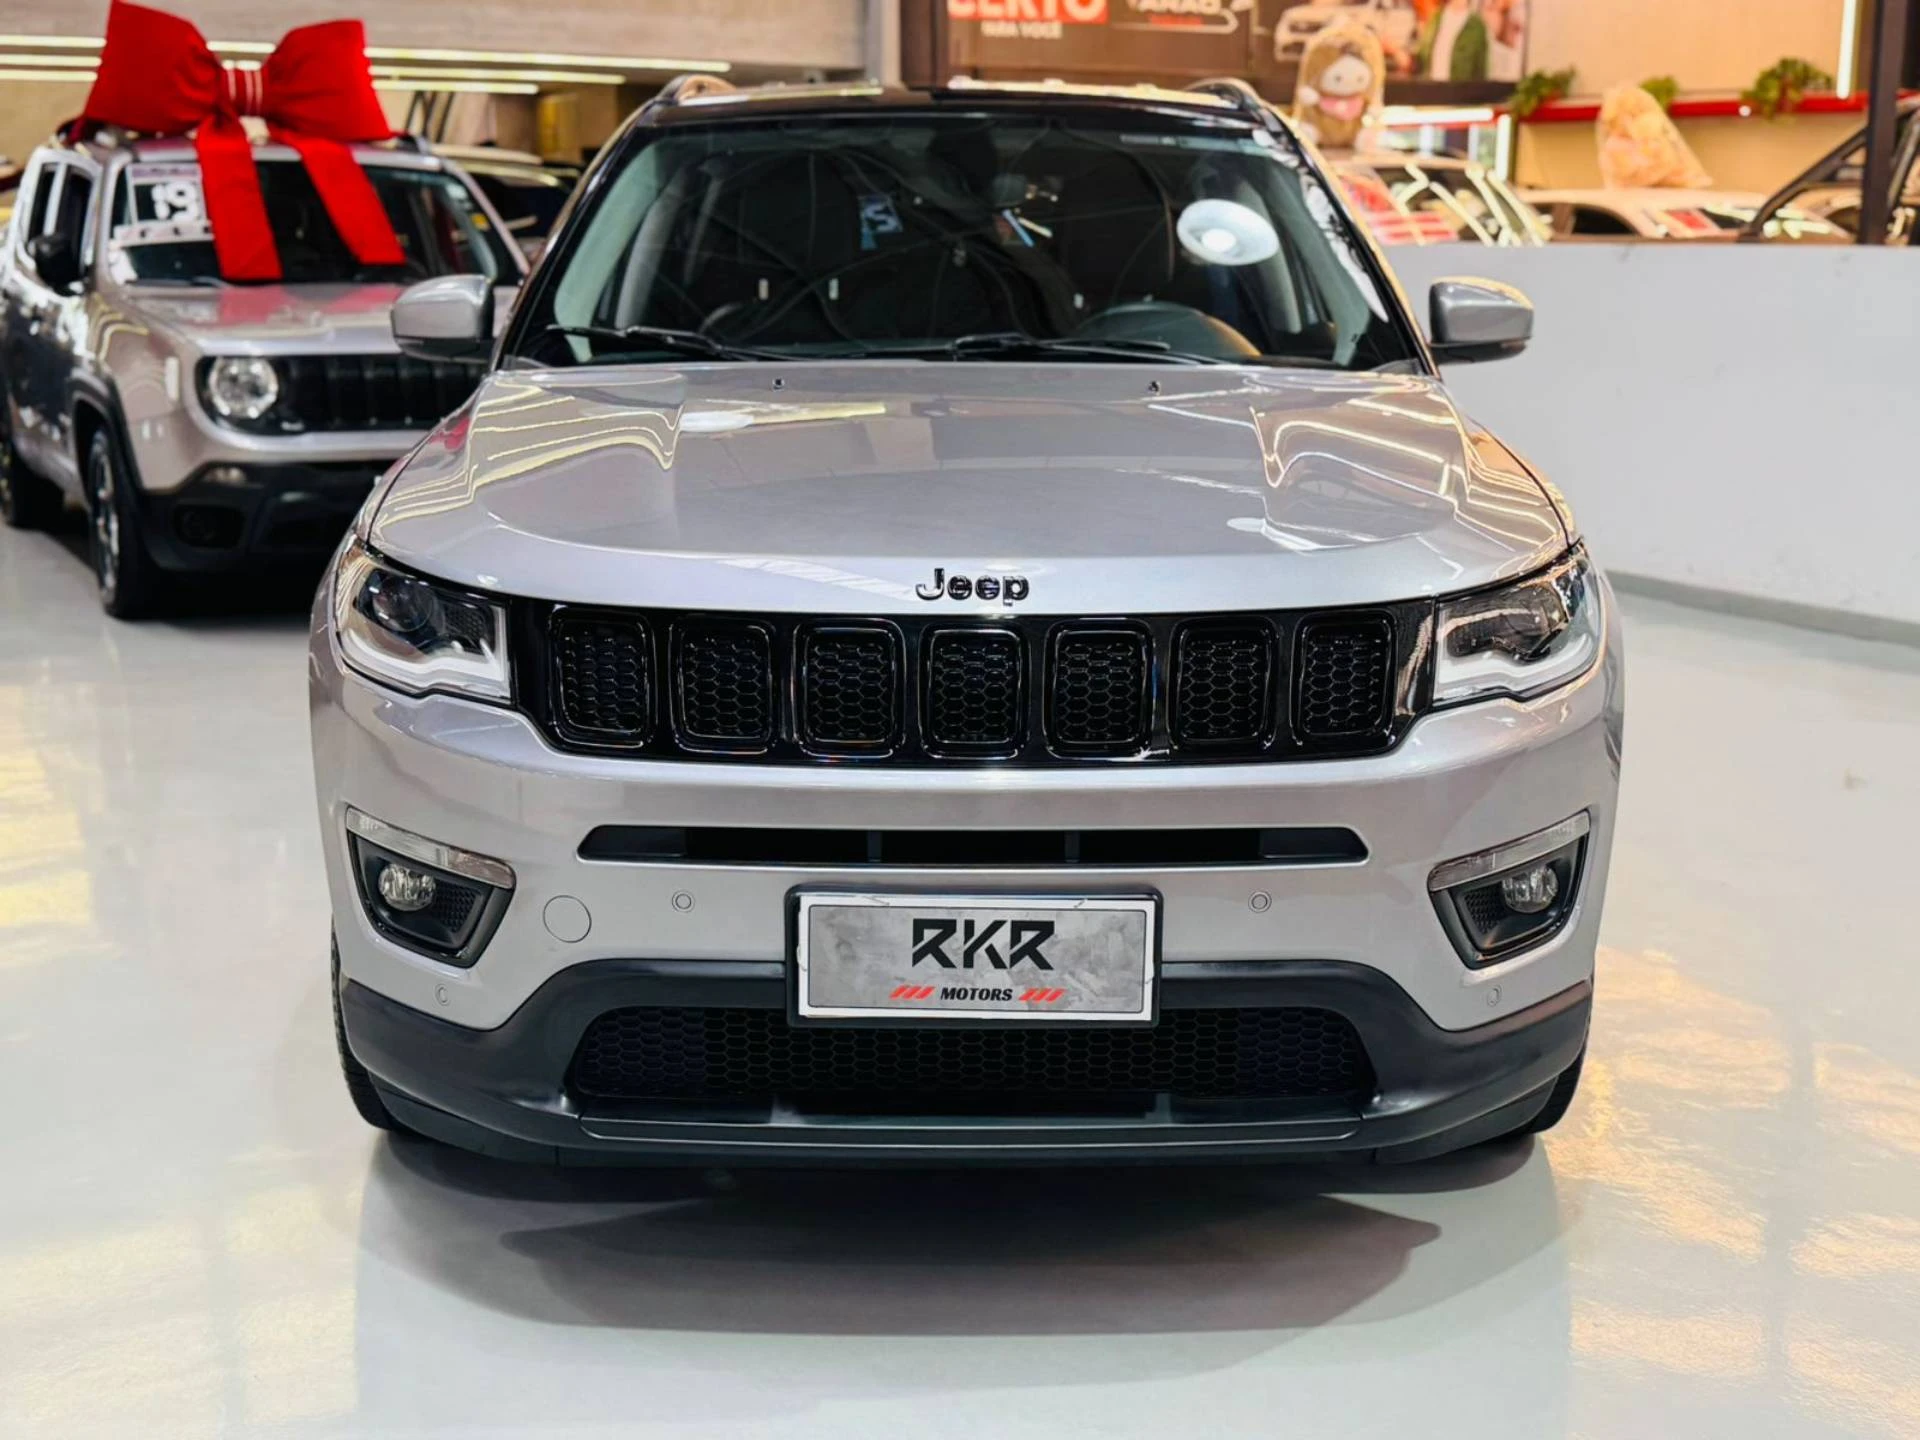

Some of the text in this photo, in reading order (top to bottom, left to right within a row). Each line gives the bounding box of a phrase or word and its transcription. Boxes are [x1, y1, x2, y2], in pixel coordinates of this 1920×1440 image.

[915, 567, 1030, 607] Jeep
[912, 918, 1055, 970] RKR
[940, 986, 1013, 1002] MOTORS
